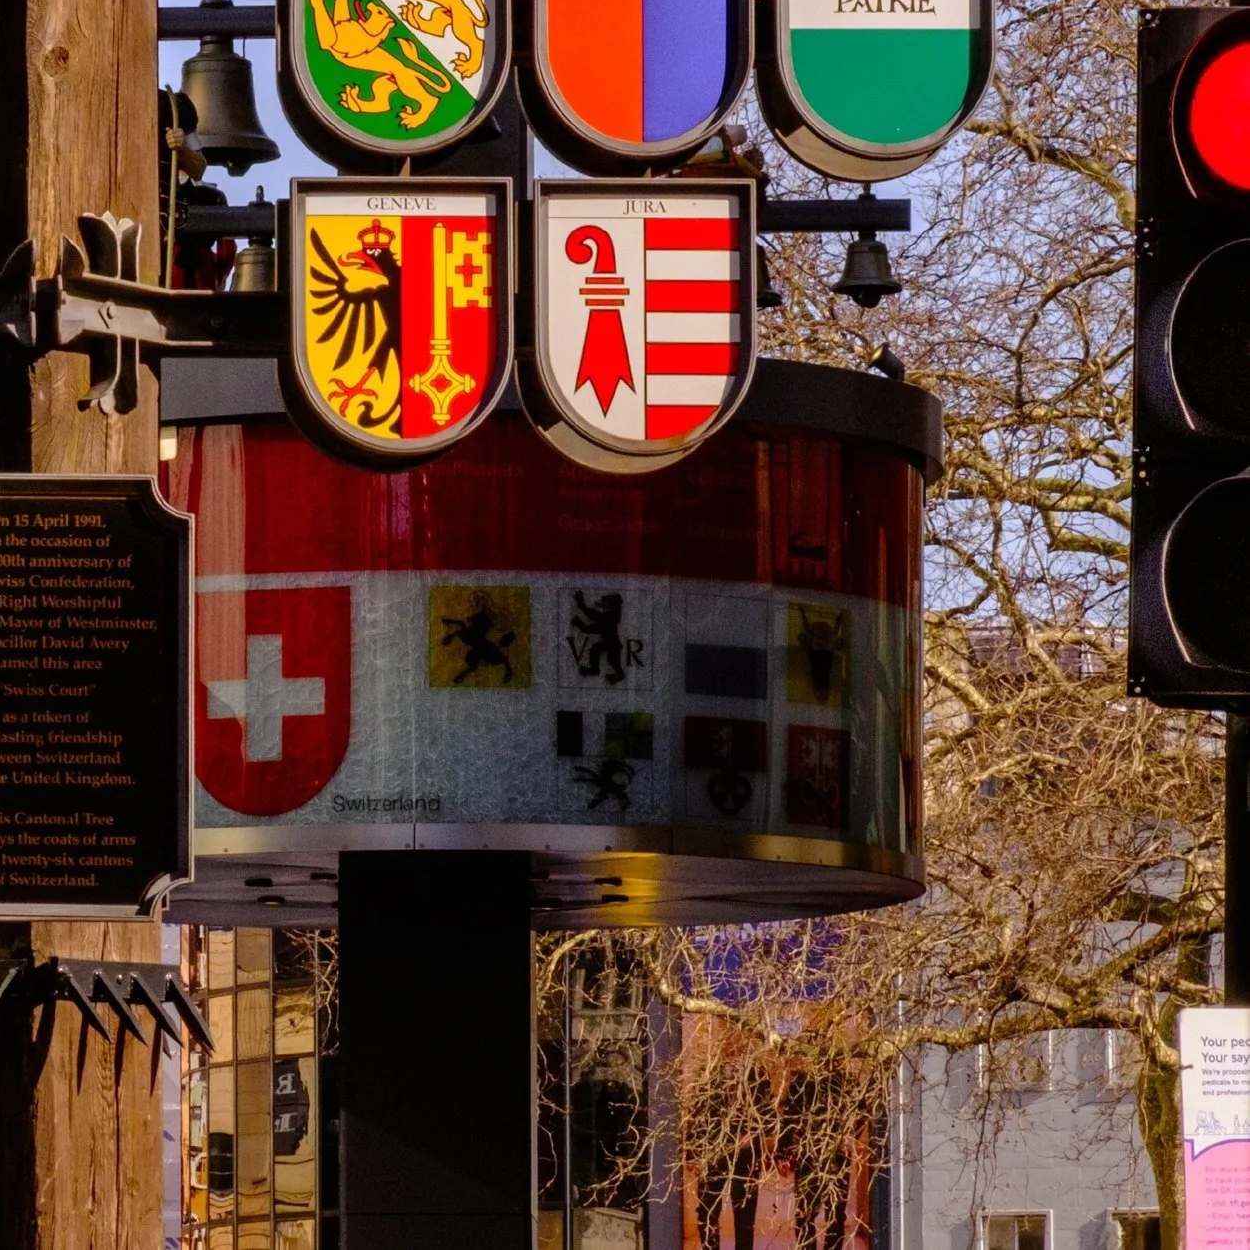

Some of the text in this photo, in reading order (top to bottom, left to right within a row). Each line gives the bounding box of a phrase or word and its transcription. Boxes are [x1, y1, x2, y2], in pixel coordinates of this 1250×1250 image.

[622, 200, 666, 214] JURA
[14, 514, 29, 527] 15
[33, 514, 69, 530] April
[5, 533, 28, 546] the
[30, 534, 92, 547] occasion
[96, 535, 110, 547] of
[29, 554, 113, 570] anniversary
[118, 555, 132, 567] of
[42, 595, 121, 611] Worshipful
[0, 615, 44, 632] Mayor
[48, 616, 62, 628] of
[42, 635, 84, 649] David
[90, 637, 130, 653] Avery
[566, 637, 645, 667] V R
[42, 656, 69, 669] this
[73, 660, 102, 669] area
[2, 710, 90, 723] as a token of
[48, 730, 122, 748] friendship
[36, 751, 121, 764] Switzerland
[12, 771, 60, 784] United
[65, 772, 135, 788] Kingdom.
[333, 795, 441, 813] Switzerland
[14, 812, 79, 824] Cantonal
[83, 812, 114, 825] Tree
[18, 832, 40, 845] the
[43, 834, 80, 845] coats
[82, 833, 96, 845] of
[101, 836, 136, 846] arms
[2, 853, 74, 868] twenty-six
[78, 855, 133, 866] cantons
[9, 872, 98, 886] Switzerland.
[1200, 1036, 1227, 1047] Your
[1201, 1052, 1228, 1063] Your
